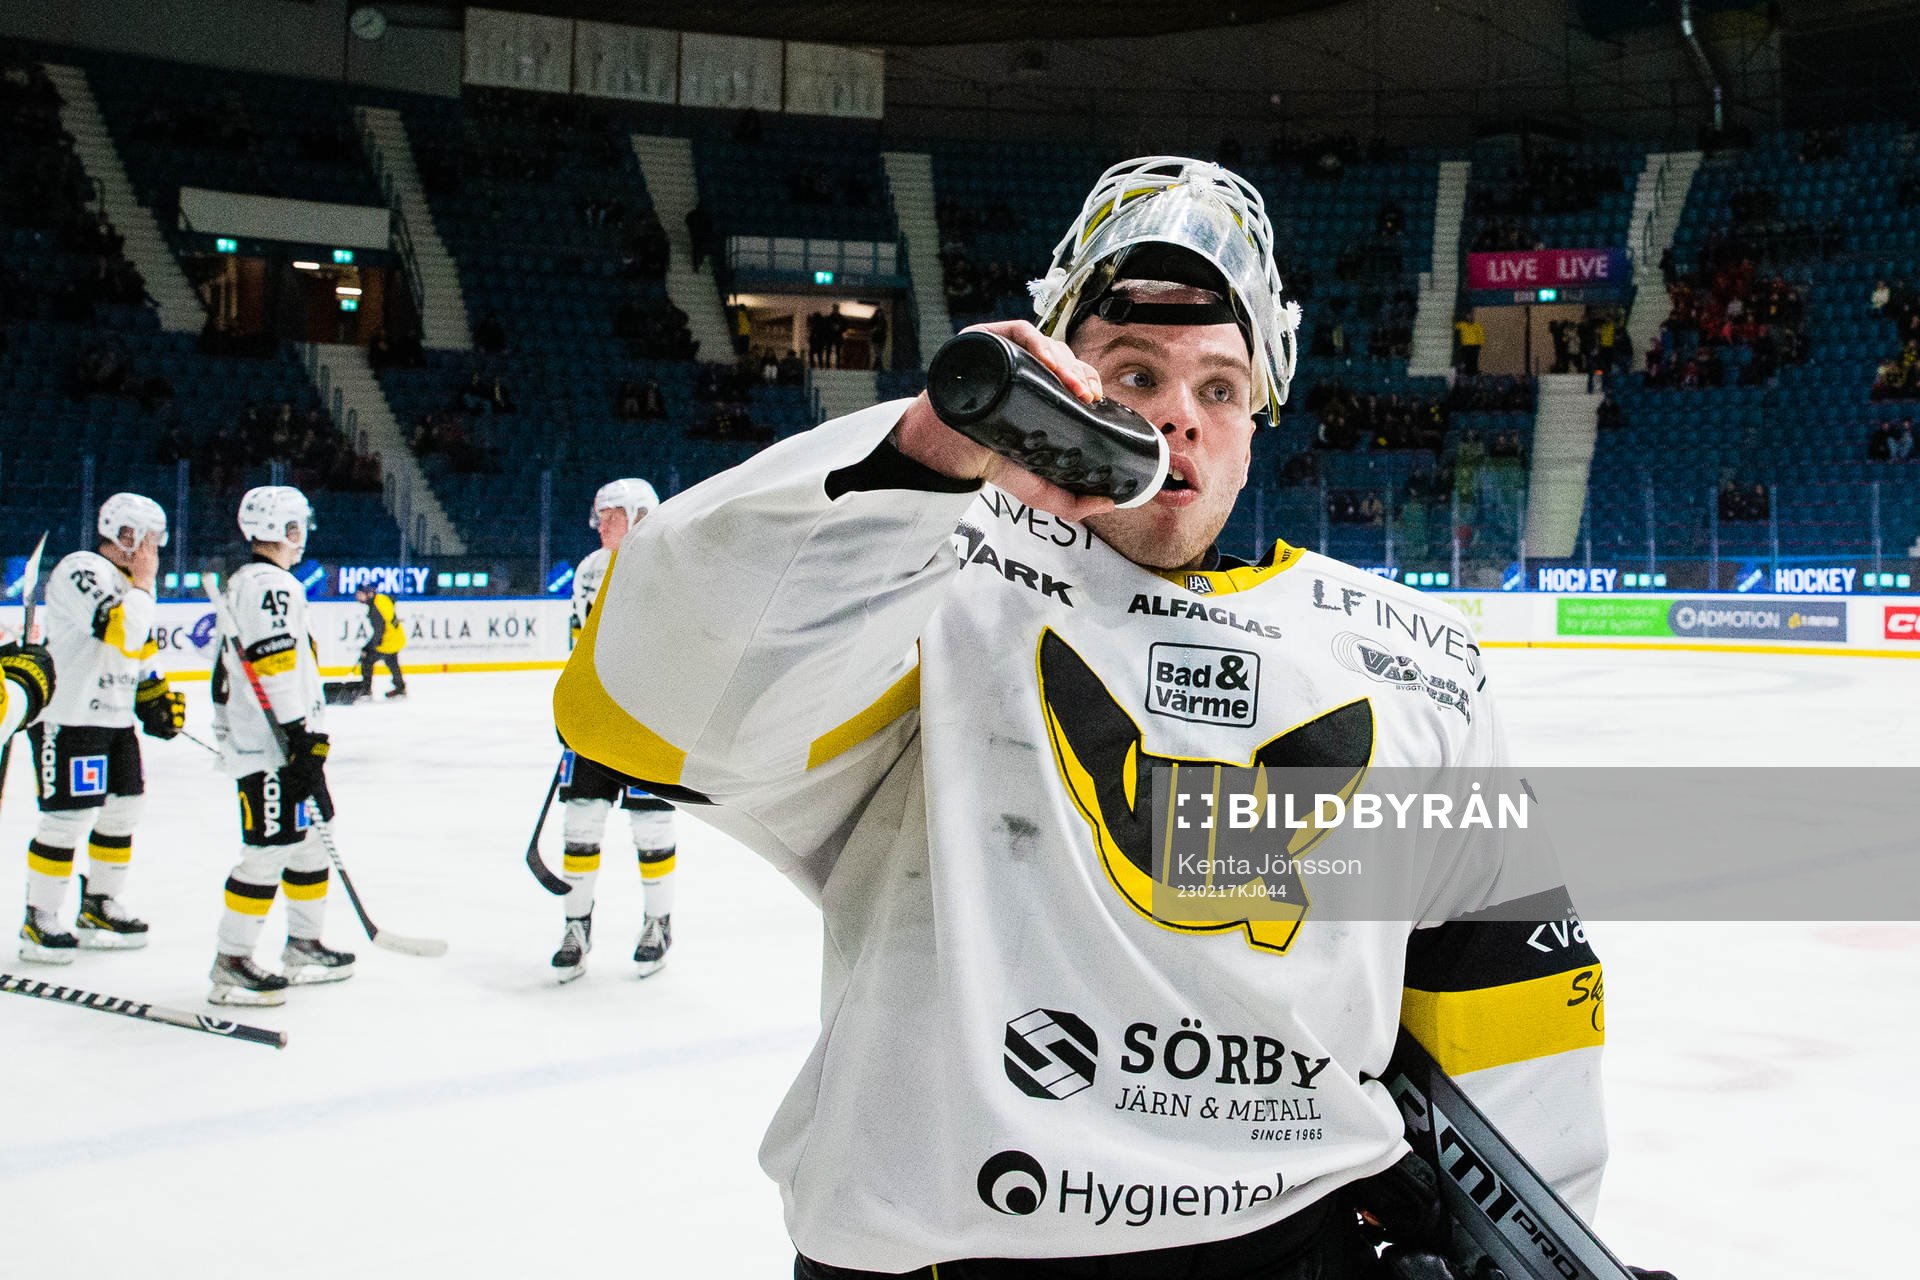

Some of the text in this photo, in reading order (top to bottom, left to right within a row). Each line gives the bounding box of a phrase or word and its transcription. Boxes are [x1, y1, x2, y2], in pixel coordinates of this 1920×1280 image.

[1487, 255, 1609, 282] LIVE LIVE
[338, 567, 430, 594] HOCKEY
[1538, 568, 1616, 592] HOCKEY
[1775, 568, 1856, 593] HOCKEY
[261, 590, 290, 615] 45
[1313, 578, 1367, 616] LF
[488, 611, 538, 637] KÖK
[1127, 594, 1282, 640] ALFAGLAS
[1156, 655, 1250, 691] Bad &
[1155, 686, 1250, 719] Värme
[1120, 1017, 1331, 1090] SÖRBY
[1115, 1085, 1321, 1122] JÄRN & METALL
[1250, 1128, 1323, 1141] SINCE 1965
[1511, 1213, 1579, 1280] PRO
